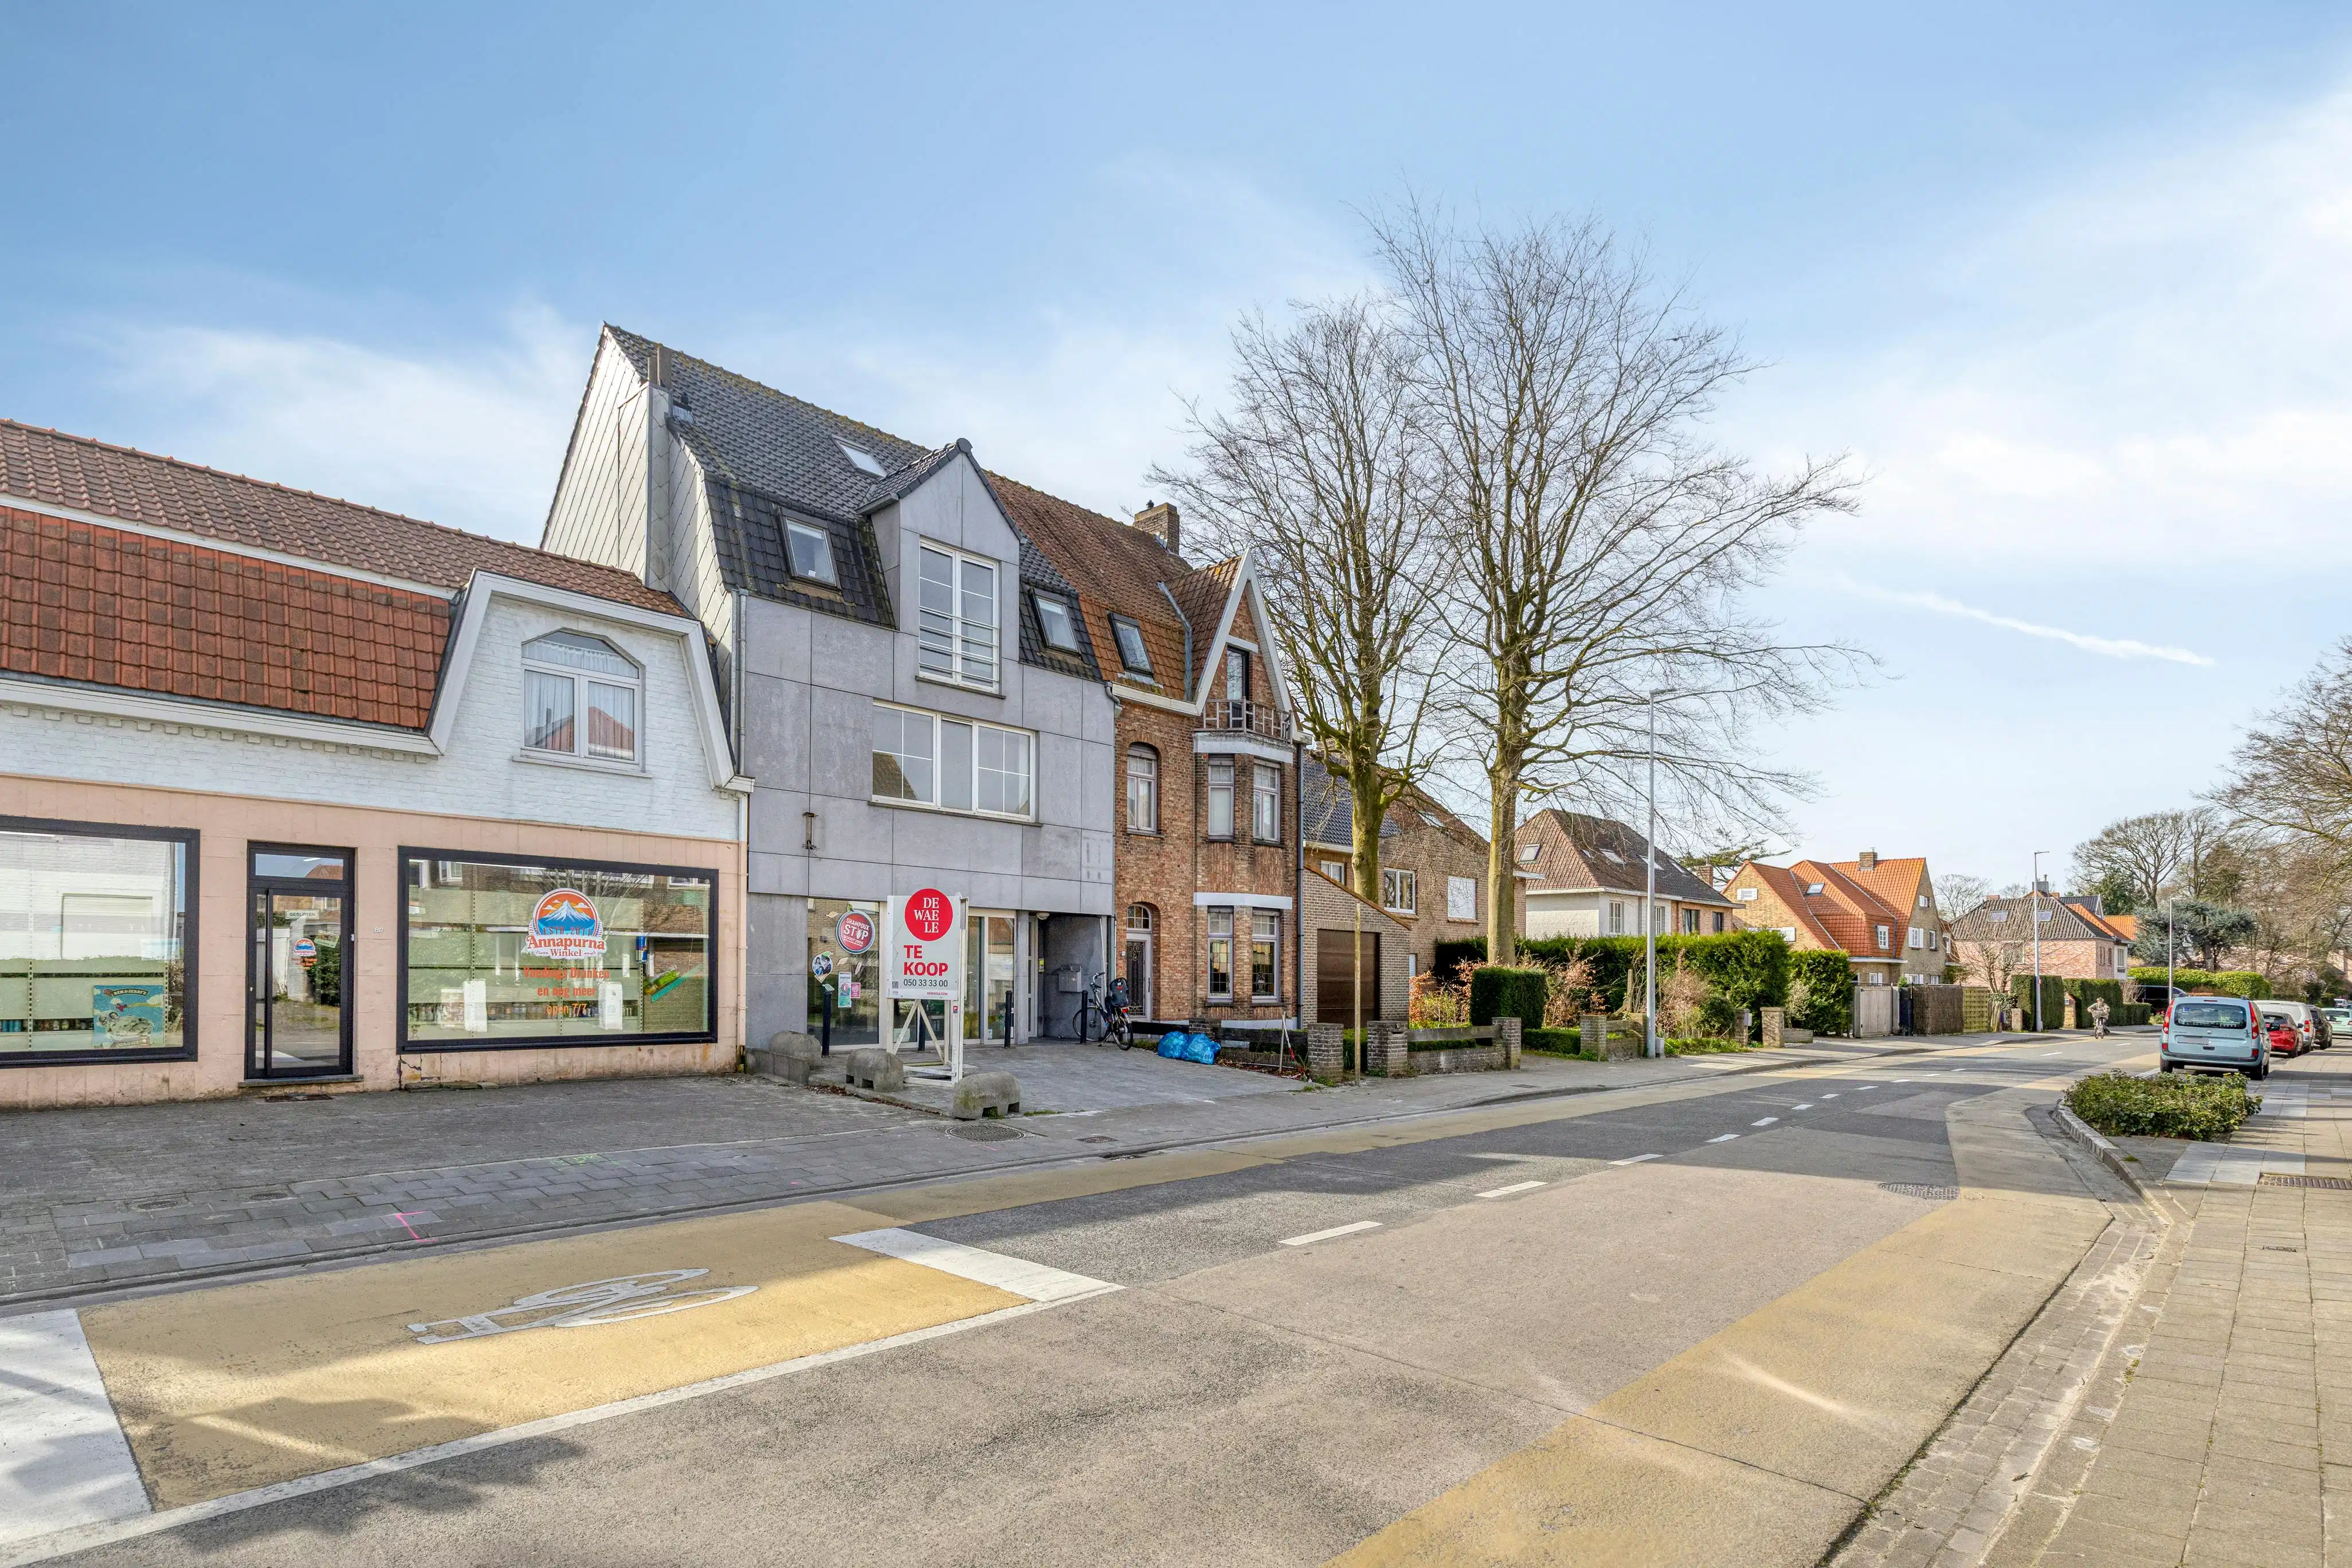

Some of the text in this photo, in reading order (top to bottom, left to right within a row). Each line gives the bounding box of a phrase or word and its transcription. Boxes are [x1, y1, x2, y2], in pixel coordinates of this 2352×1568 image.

[923, 897, 939, 908] DE
[914, 910, 939, 920] WAE
[845, 918, 870, 931] SHAMPOUX
[924, 922, 939, 933] LE
[526, 935, 605, 950] Annapurna
[550, 948, 582, 957] Winkel
[903, 945, 923, 959] TE
[523, 967, 610, 981] Voedings Dranken
[904, 962, 948, 977] KOOP
[538, 987, 597, 998] en nog meer
[546, 1002, 587, 1017] open 7/7
